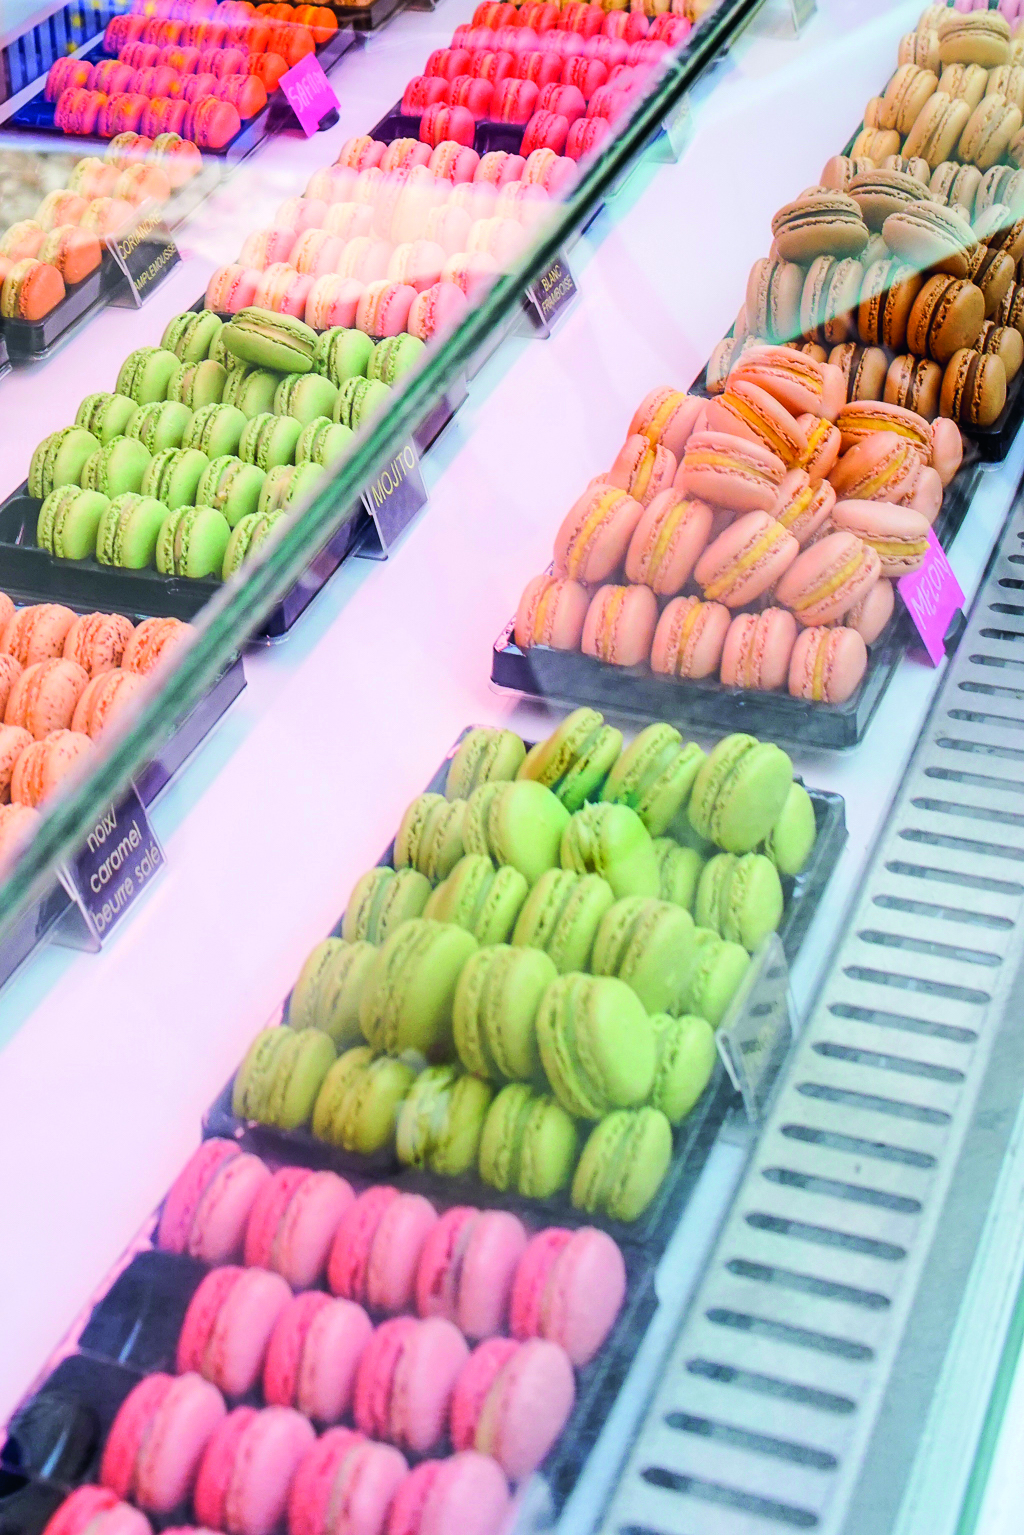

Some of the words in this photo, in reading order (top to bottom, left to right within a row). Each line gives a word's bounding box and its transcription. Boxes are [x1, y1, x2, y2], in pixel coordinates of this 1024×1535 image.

[118, 210, 163, 260] CORIANDRE
[133, 242, 177, 291] AMPLEMOUSSE
[541, 264, 562, 292] BLANC
[541, 274, 573, 315] FRAMBOISE
[371, 445, 415, 507] MOJITO
[910, 547, 952, 630] MELON
[90, 820, 143, 893] caramel
[92, 877, 135, 932] beurre
[134, 841, 161, 884] salé
